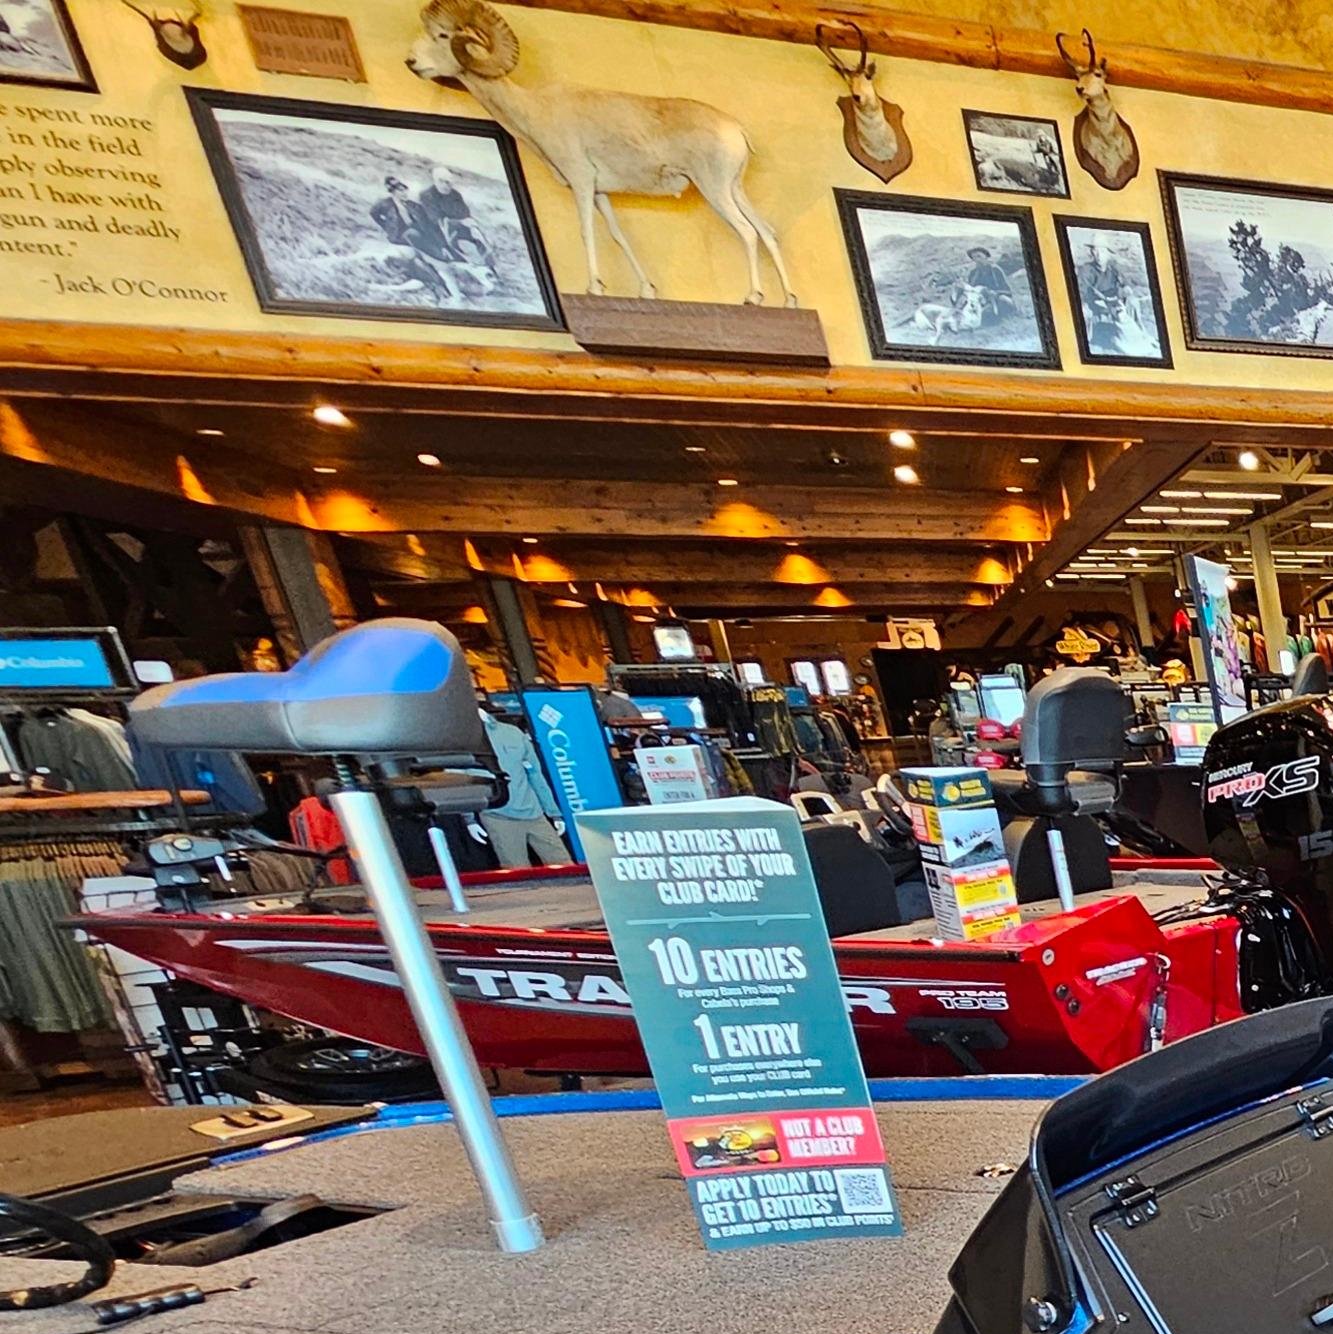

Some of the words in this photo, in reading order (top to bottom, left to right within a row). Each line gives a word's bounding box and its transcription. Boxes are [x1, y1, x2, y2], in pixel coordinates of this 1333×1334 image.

[14, 106, 82, 123] spent
[91, 112, 152, 132] more
[9, 127, 34, 146] in
[43, 131, 80, 151] the
[89, 135, 142, 157] field
[45, 159, 162, 188] observing
[30, 183, 41, 200] I
[48, 185, 102, 206] have
[108, 191, 164, 212] with
[0, 216, 46, 228] gun
[55, 215, 99, 232] and
[106, 217, 181, 241] deadly
[54, 273, 107, 295] Jack
[112, 277, 228, 303] O'Connor
[1208, 771, 1266, 803] PRO
[1242, 755, 1320, 807] XS
[1209, 762, 1253, 783] MERCURY
[612, 830, 663, 855] EARN
[663, 828, 736, 854] ENTRIES
[735, 828, 782, 852] WITH
[611, 856, 669, 881] EVERY
[669, 855, 726, 879] SWIPE
[727, 855, 749, 878] OF
[749, 852, 796, 876] YOUR
[657, 881, 704, 905] CLUB
[648, 937, 699, 985] 10
[700, 946, 807, 983] ENTRIES
[742, 985, 759, 995] Pro
[937, 997, 1009, 1010] 195
[693, 1012, 721, 1060] 1
[721, 1022, 802, 1058] ENTRY
[780, 1118, 810, 1137] NOT
[814, 1117, 827, 1136] A
[826, 1116, 865, 1136] CLUB
[786, 1136, 857, 1158] MEMBER?
[696, 1176, 752, 1203] APPLY
[752, 1171, 809, 1197] TODAY
[808, 1170, 835, 1192] TO
[1184, 1154, 1312, 1234] NITRO
[701, 1201, 737, 1226] GET
[737, 1198, 761, 1221] 10
[709, 1226, 721, 1239] &
[721, 1224, 755, 1238] EARN
[755, 1221, 771, 1234] UP
[771, 1219, 789, 1231] TO
[813, 1216, 826, 1227] IN
[826, 1215, 855, 1227] CLUB
